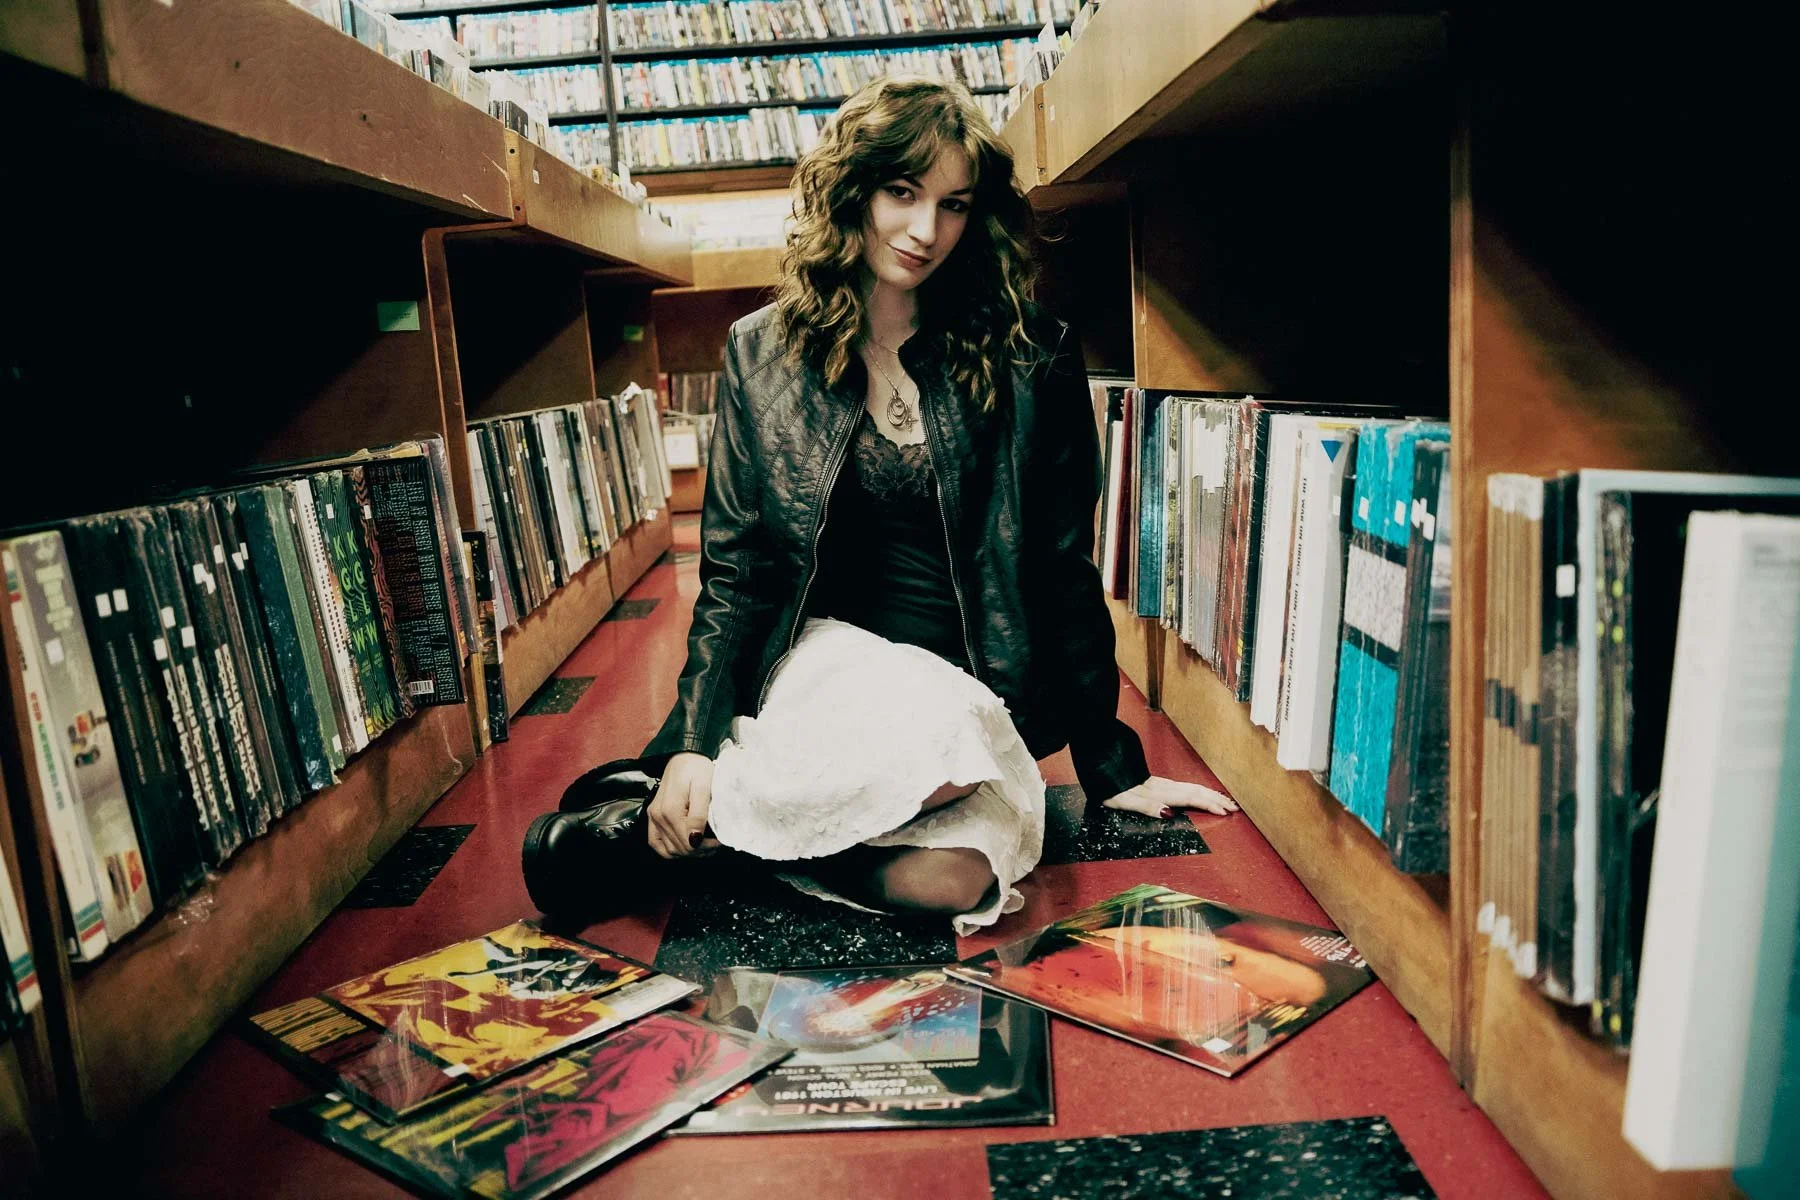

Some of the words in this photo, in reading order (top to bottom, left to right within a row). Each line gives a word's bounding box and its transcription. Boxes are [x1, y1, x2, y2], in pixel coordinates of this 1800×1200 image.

[1298, 525, 1304, 540] ON
[407, 481, 425, 502] LIVE
[422, 581, 443, 611] MUSIC
[926, 1060, 980, 1069] JONATHAN
[807, 1081, 847, 1091] TOUR
[850, 1078, 908, 1090] ESCAPE
[774, 1091, 808, 1101] 1981
[811, 1088, 882, 1099] HOUSTON
[883, 1087, 903, 1097] IN
[904, 1085, 938, 1096] LIVE
[734, 1095, 984, 1117] JOURNEY
